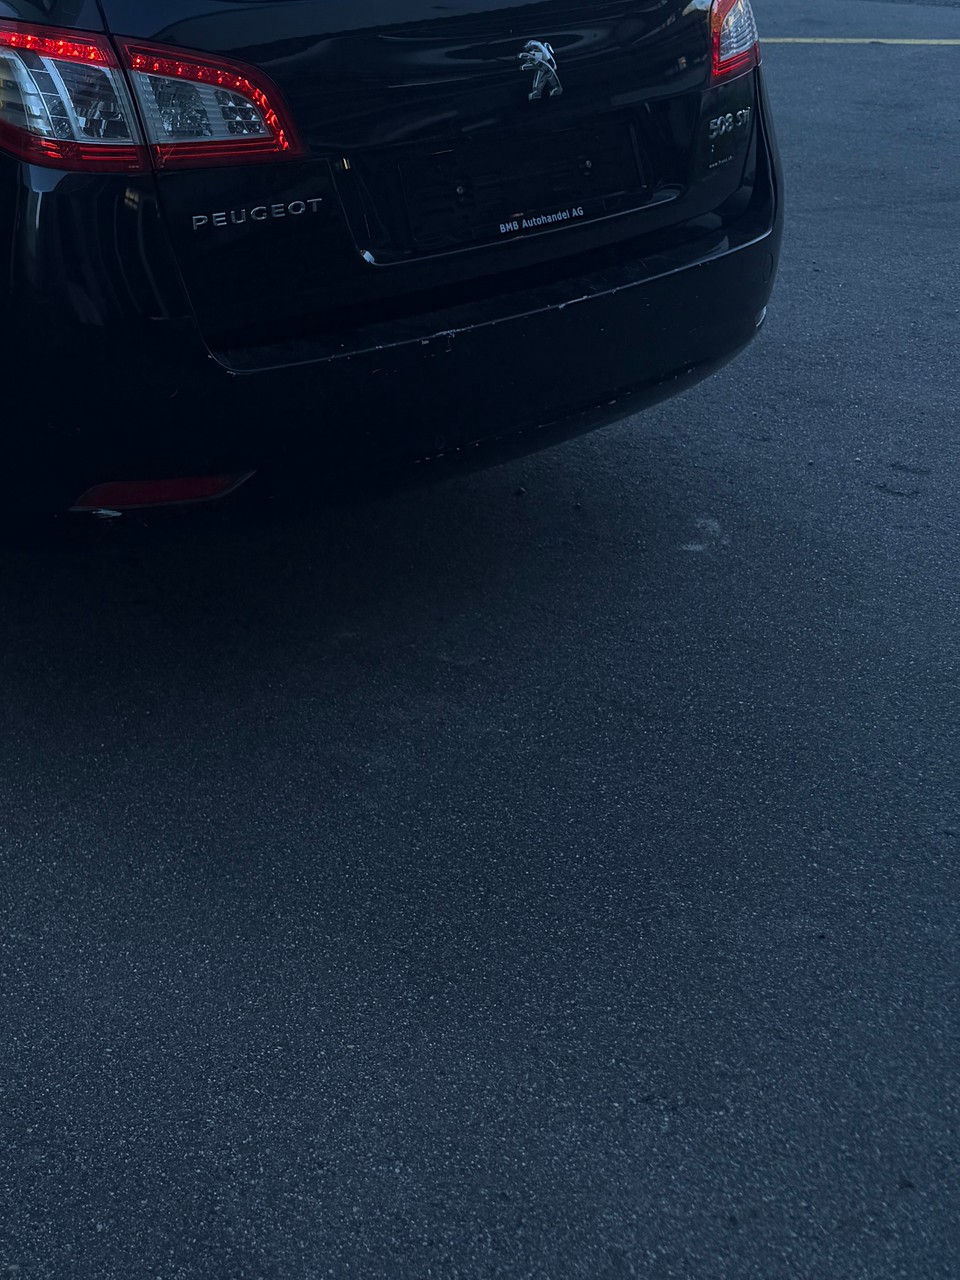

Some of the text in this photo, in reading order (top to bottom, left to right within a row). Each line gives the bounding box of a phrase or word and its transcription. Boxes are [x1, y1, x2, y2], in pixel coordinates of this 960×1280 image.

[709, 112, 733, 138] 508
[192, 197, 323, 231] PEUGEOT
[499, 206, 584, 233] BMB Autohandel AG
